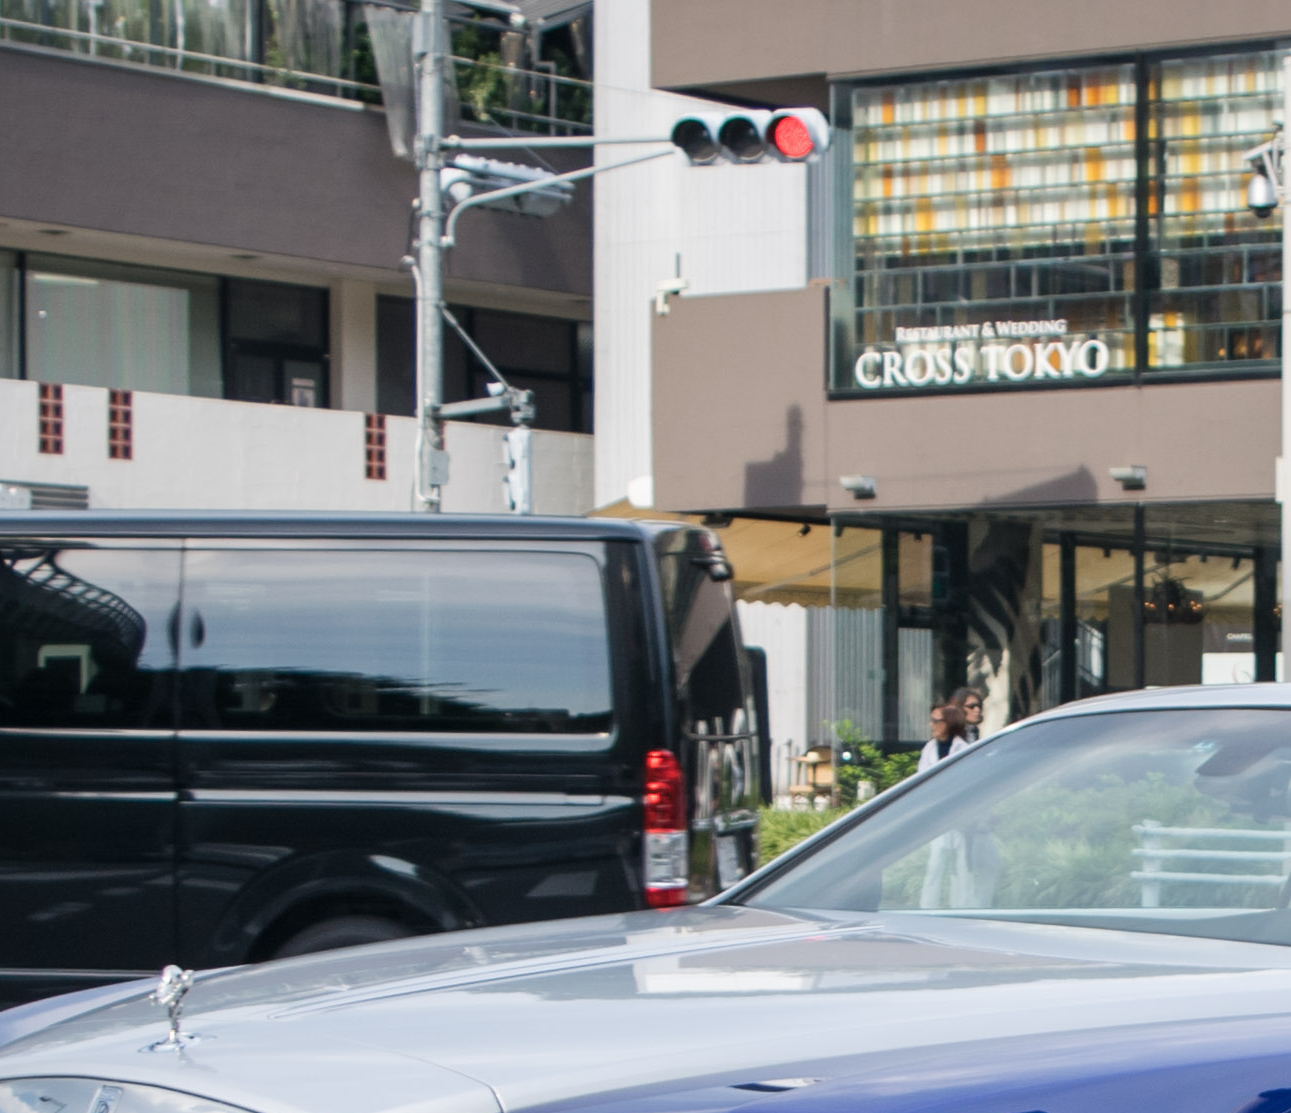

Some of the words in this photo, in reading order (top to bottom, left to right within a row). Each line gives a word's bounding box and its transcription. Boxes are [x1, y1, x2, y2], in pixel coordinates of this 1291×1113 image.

[895, 324, 980, 342] RESTAURANT
[981, 321, 995, 337] &
[995, 319, 1068, 337] WEDDING
[855, 346, 973, 389] CROSS
[980, 339, 1110, 382] TOKYO
